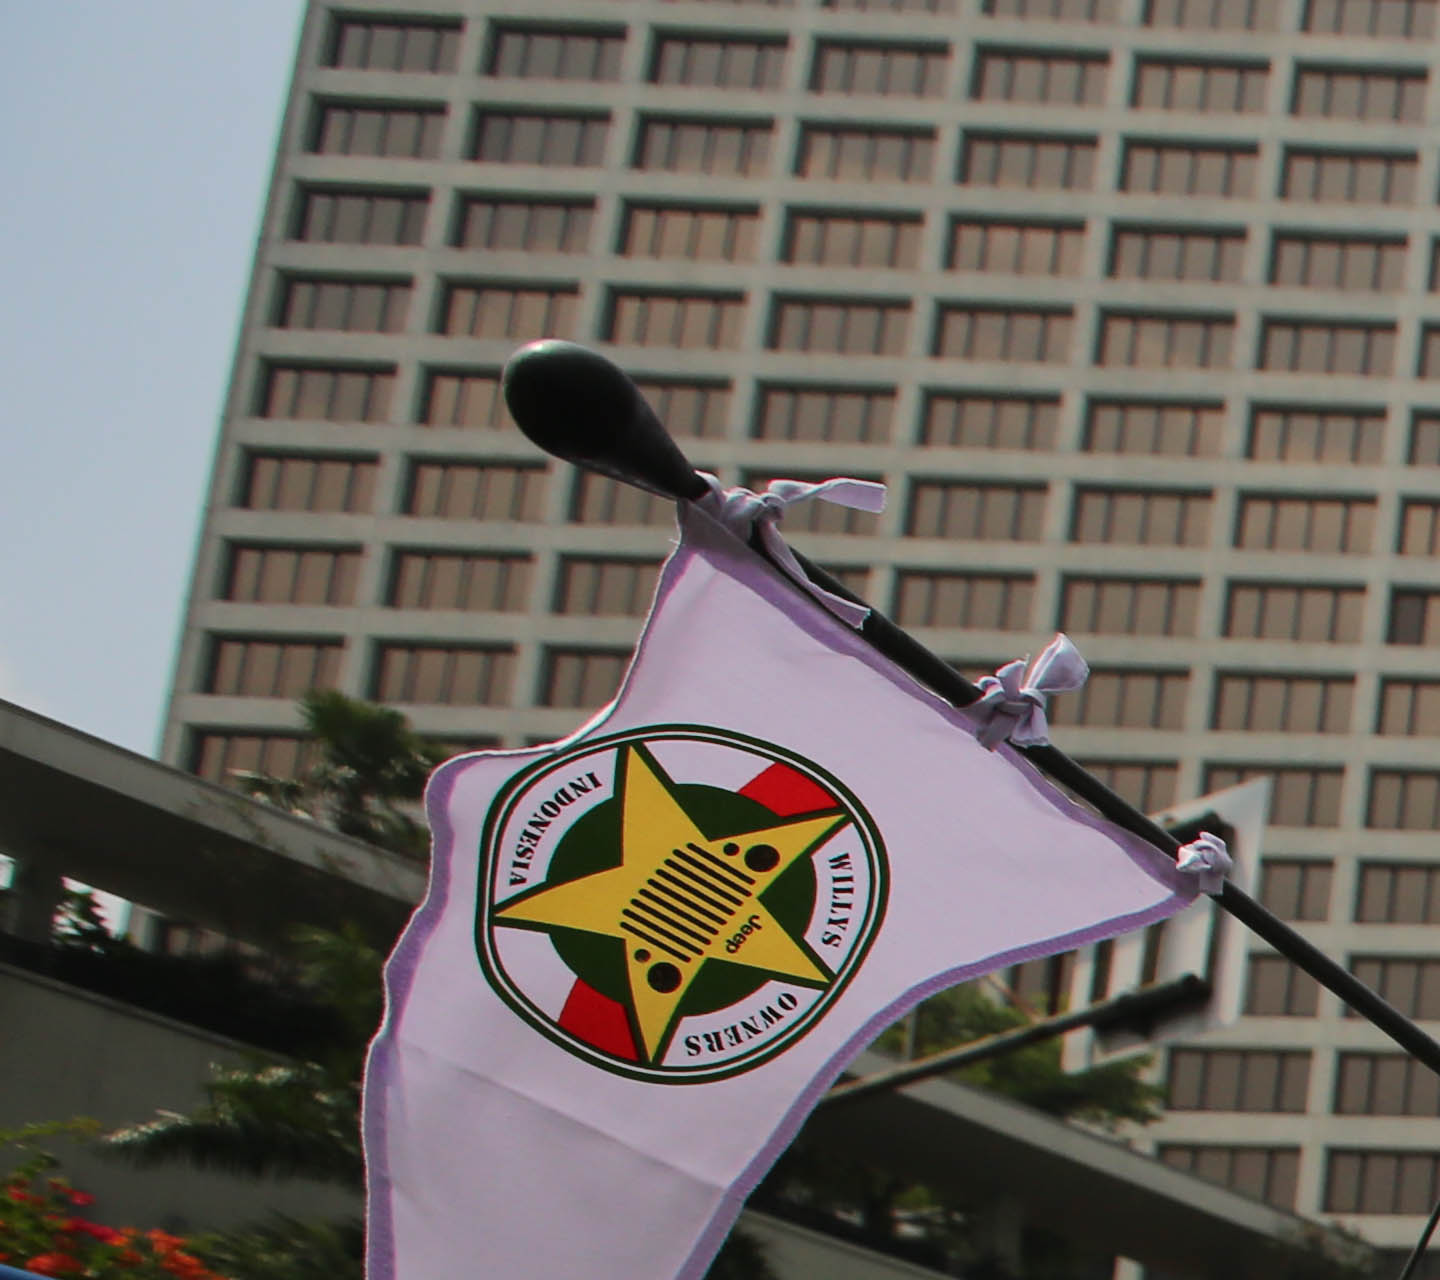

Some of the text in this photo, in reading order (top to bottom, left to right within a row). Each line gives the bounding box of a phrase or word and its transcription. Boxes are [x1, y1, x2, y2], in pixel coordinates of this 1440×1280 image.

[509, 771, 602, 888] INDONESIA
[725, 914, 762, 954] Jeep
[821, 852, 854, 948] WILLYS
[684, 992, 798, 1057] OWNERS
